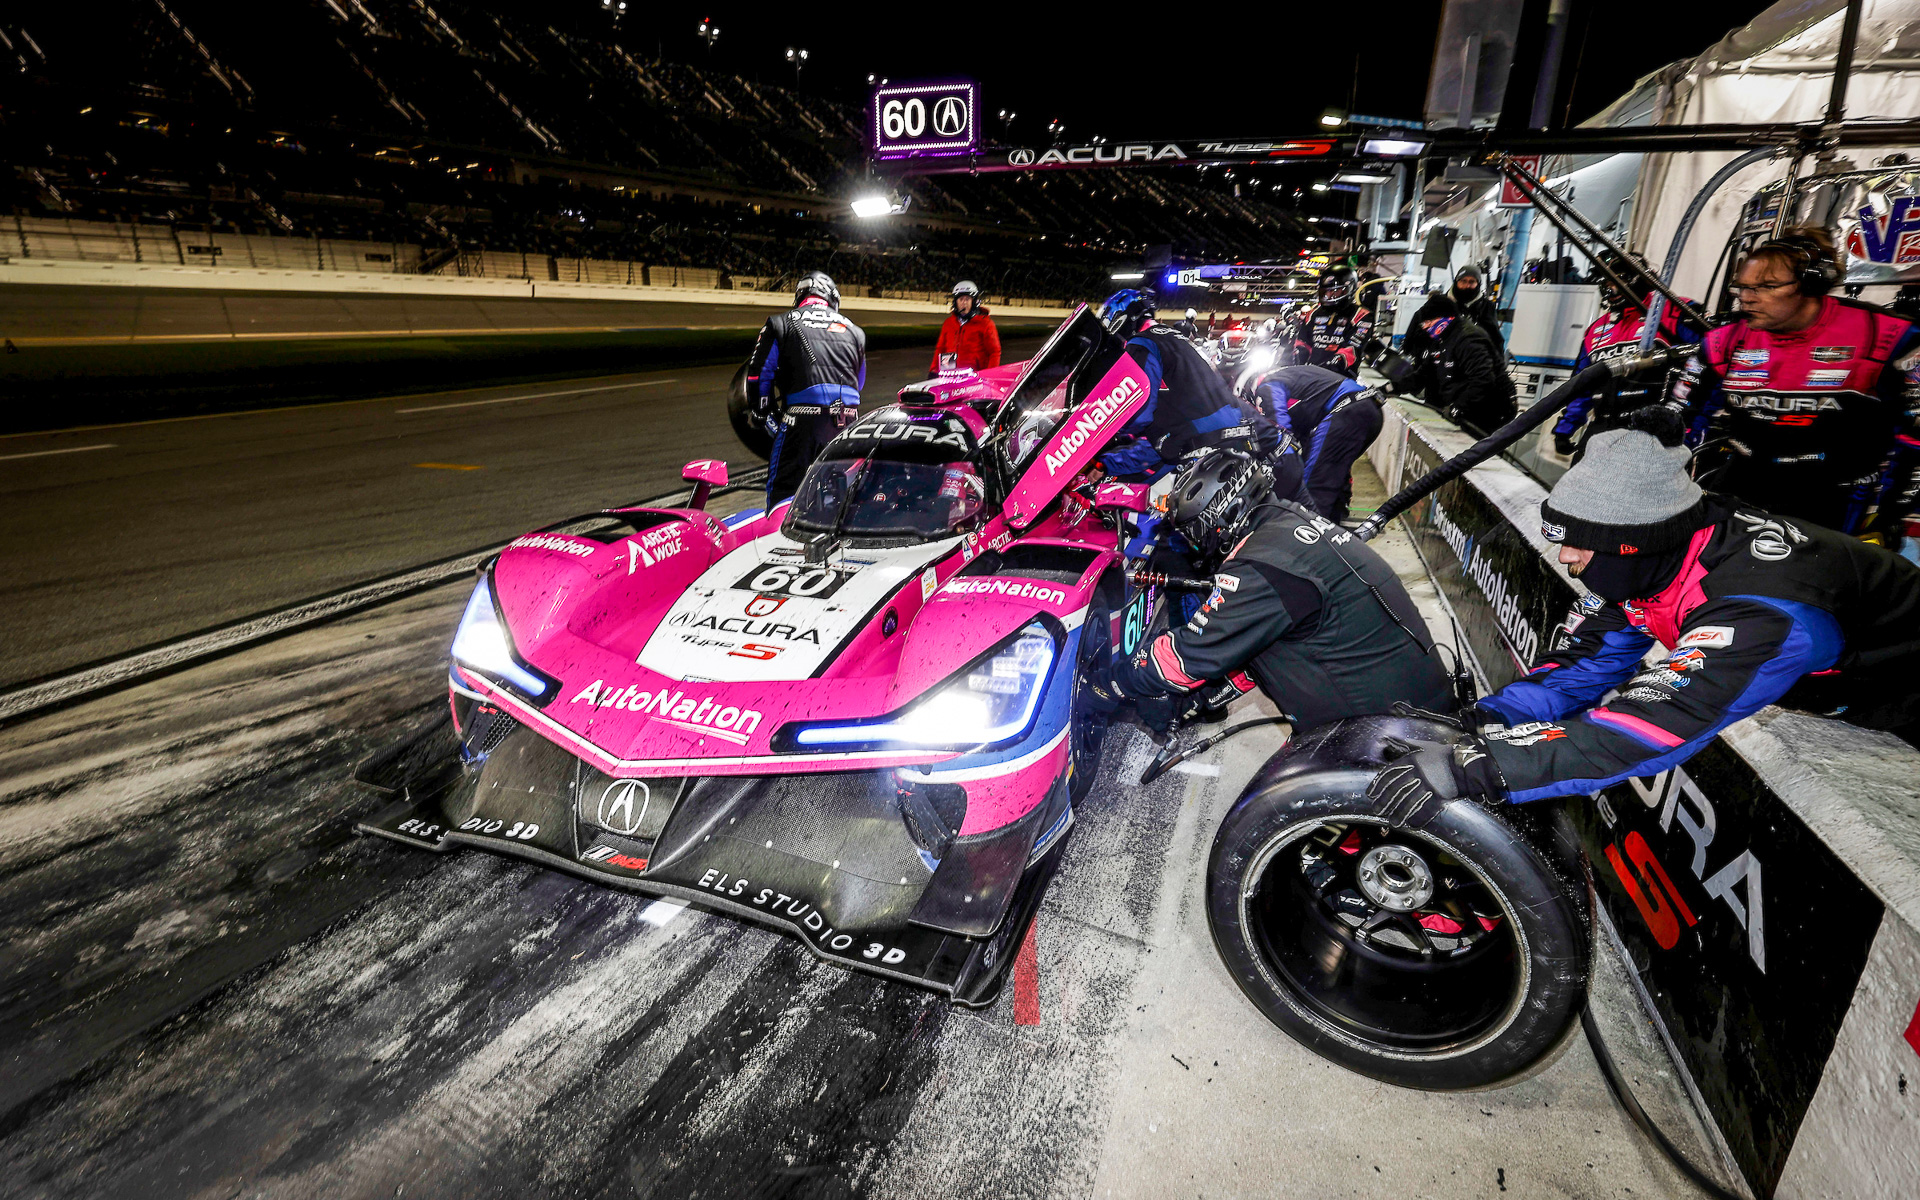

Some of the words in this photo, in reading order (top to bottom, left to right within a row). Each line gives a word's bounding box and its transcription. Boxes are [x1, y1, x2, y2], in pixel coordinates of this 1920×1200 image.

[882, 97, 926, 139] 60
[1036, 142, 1188, 166] ACURA
[1197, 142, 1274, 154] Type
[1183, 273, 1197, 285] 01
[1596, 344, 1641, 362] ACUR
[1743, 395, 1844, 412] ACURA
[837, 423, 969, 453] ACURA
[1044, 375, 1140, 478] AutoNation
[1216, 460, 1260, 519] SCOTT
[508, 532, 596, 558] AutoNation
[641, 522, 681, 548] ARCTIC
[651, 537, 684, 564] WOLF
[749, 565, 837, 597] 60
[934, 577, 1067, 606] AutoNation
[1469, 544, 1539, 668] AutoNation
[694, 613, 821, 646] ACURA
[1124, 592, 1145, 656] 60
[681, 632, 735, 650] Type
[726, 642, 786, 662] S
[571, 679, 763, 734] AutoNation
[397, 818, 440, 837] ELS
[504, 821, 541, 841] 3D
[1627, 763, 1766, 975] URA
[697, 867, 750, 897] ELS
[752, 888, 854, 951] STUDIO
[862, 942, 907, 966] 3D
